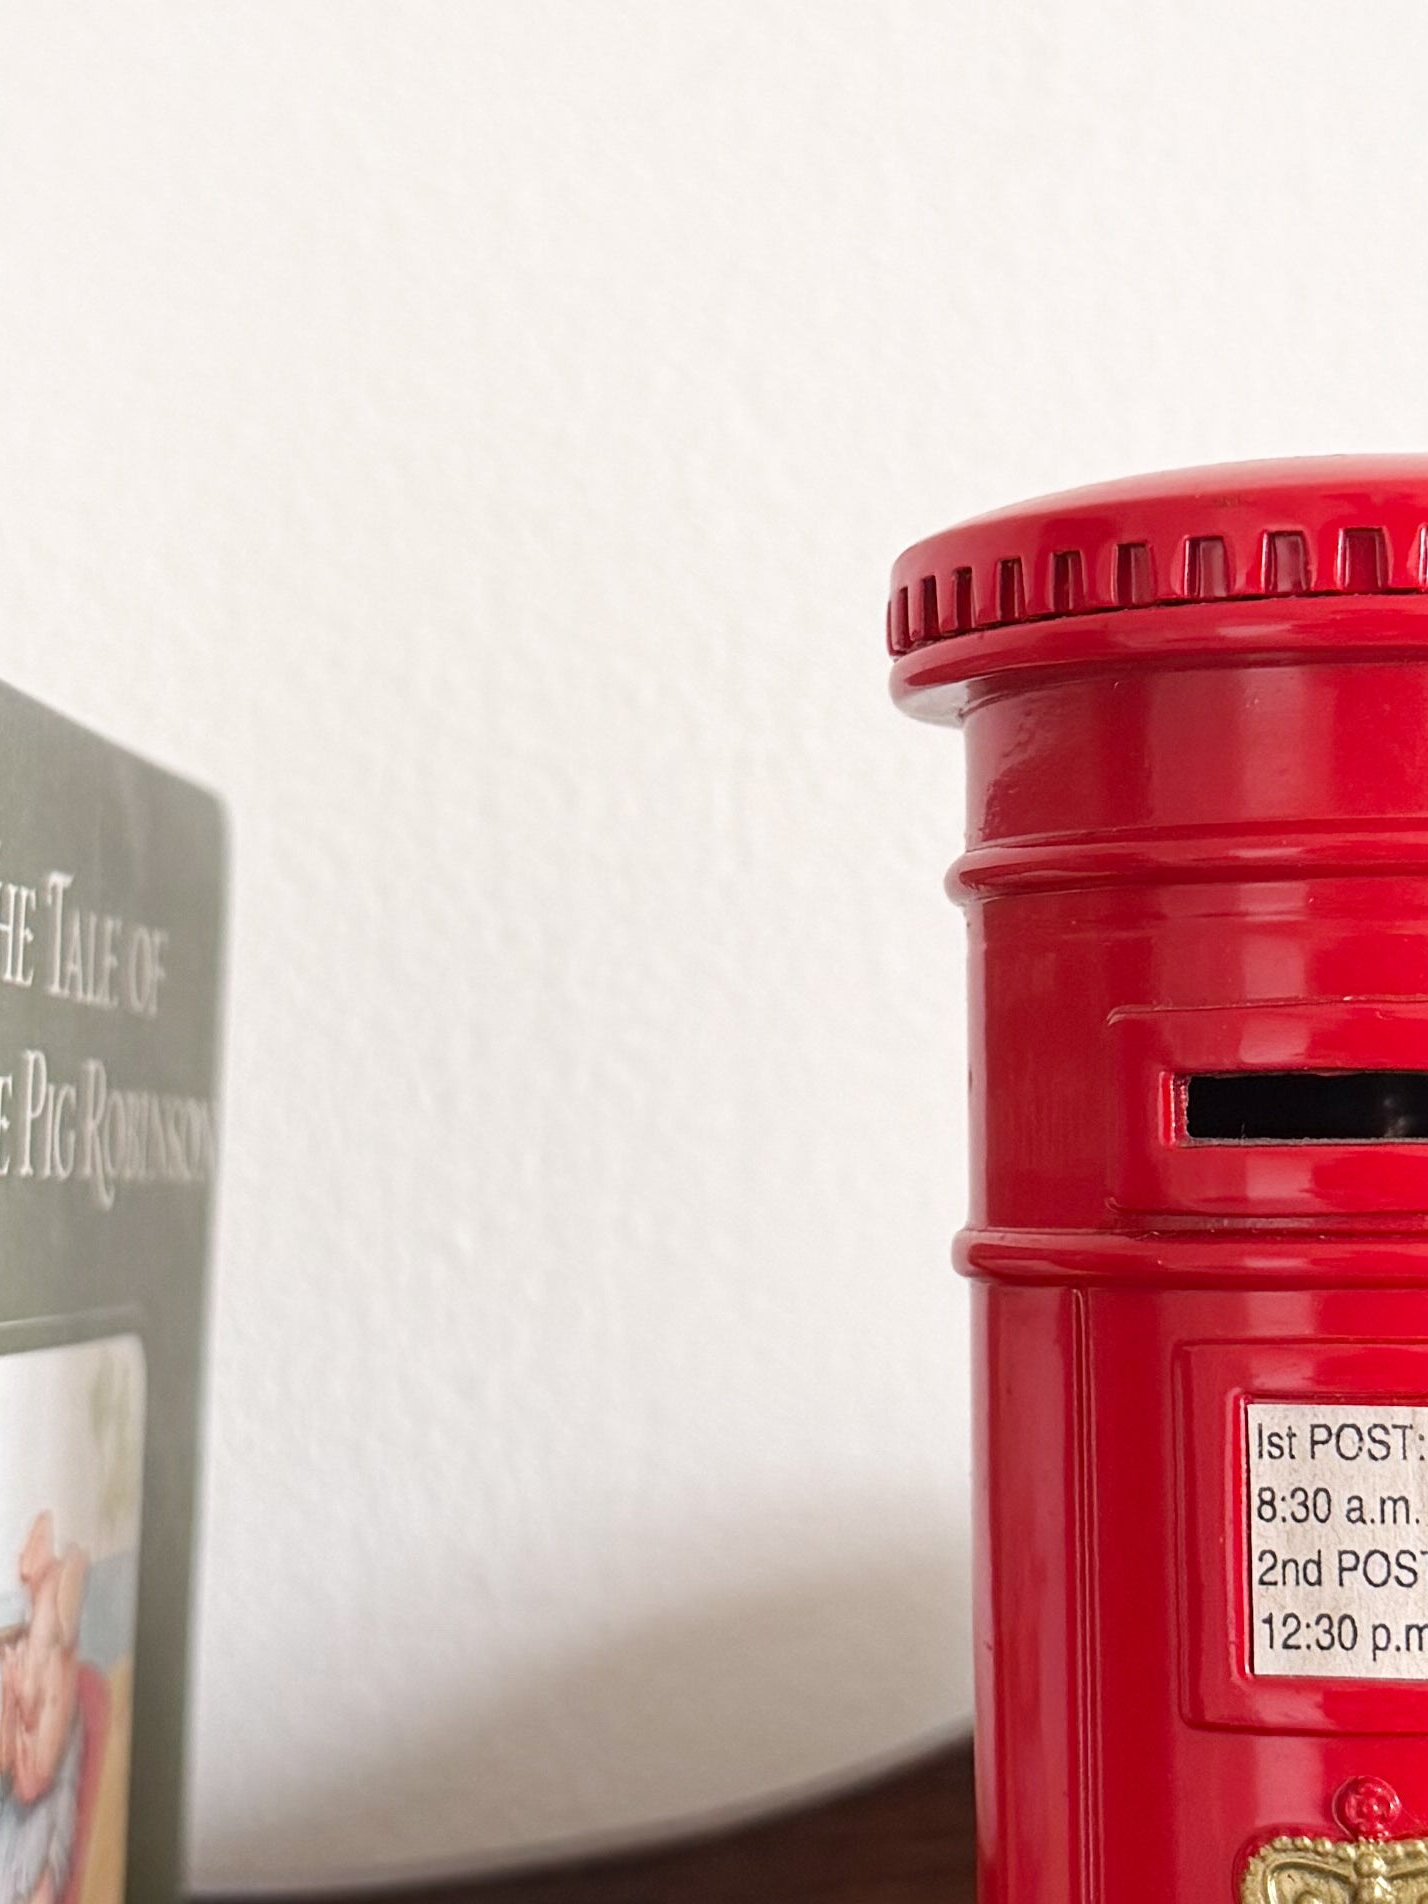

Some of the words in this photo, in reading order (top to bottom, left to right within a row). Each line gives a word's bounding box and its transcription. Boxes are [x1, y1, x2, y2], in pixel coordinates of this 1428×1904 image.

[46, 870, 123, 1012] TALE
[19, 1049, 77, 1182] PIG
[1310, 1423, 1425, 1461] POST:
[1257, 1486, 1332, 1524] 8:30
[1345, 1495, 1420, 1525] a.m.
[1258, 1549, 1321, 1586] 2nd
[1262, 1612, 1358, 1651] 12:30
